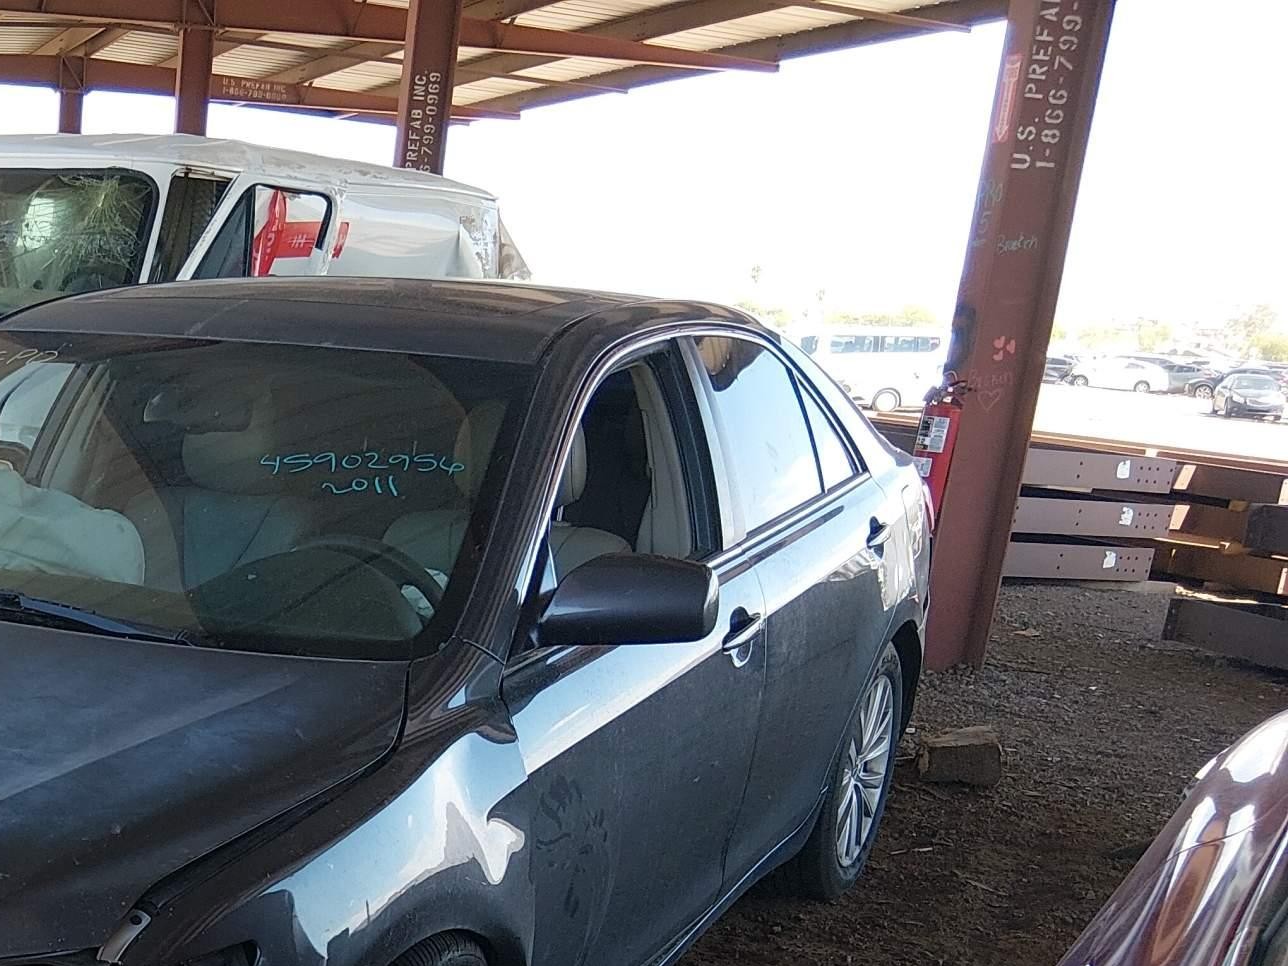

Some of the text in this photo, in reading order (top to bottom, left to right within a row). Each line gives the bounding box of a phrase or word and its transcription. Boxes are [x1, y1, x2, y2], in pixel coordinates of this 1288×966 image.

[1010, 0, 1062, 170] U.S. PREFA
[405, 70, 428, 170] PREFAB INC.
[260, 452, 465, 476] 45902956
[321, 475, 398, 497] 2011
